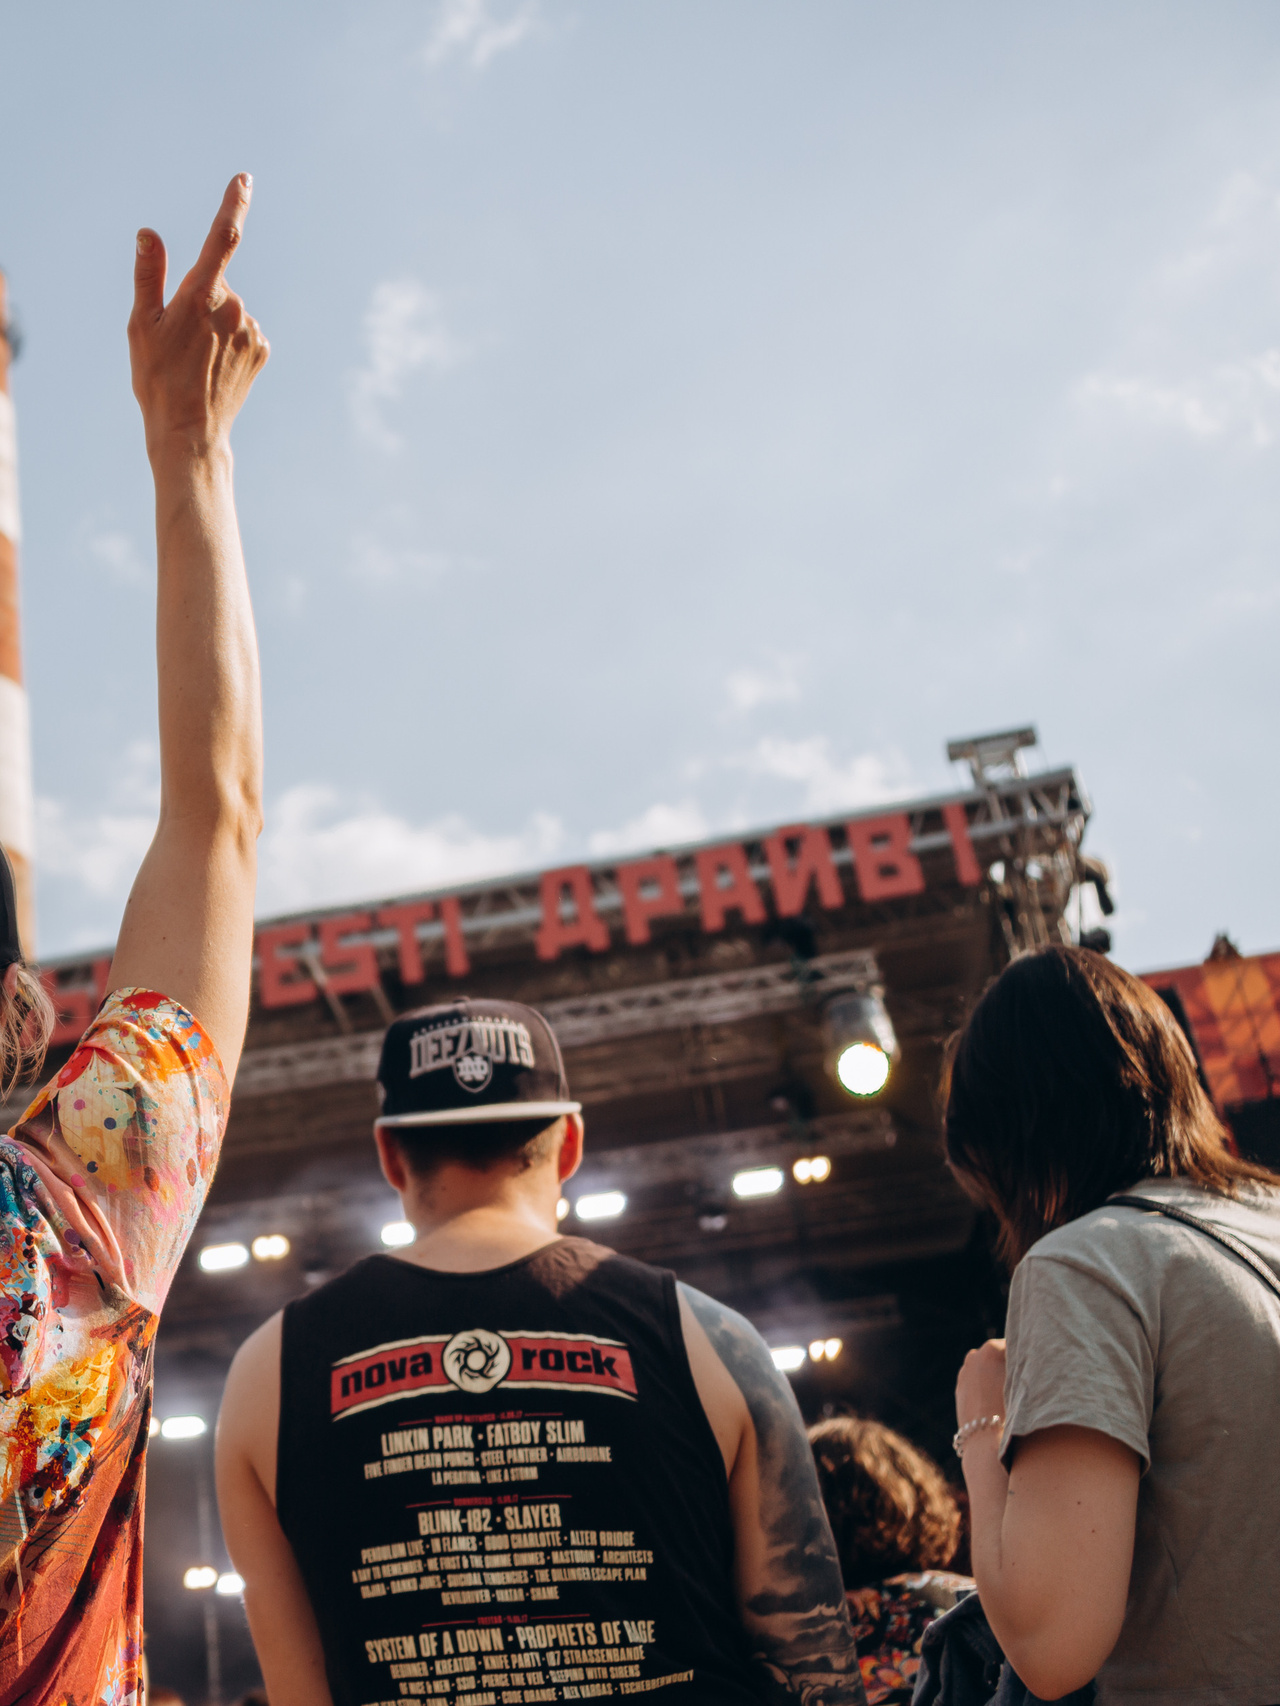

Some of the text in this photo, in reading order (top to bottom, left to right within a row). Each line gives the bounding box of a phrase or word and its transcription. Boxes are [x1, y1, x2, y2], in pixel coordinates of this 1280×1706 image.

[255, 896, 471, 1010] ESTI
[341, 1347, 620, 1398] nova rock
[381, 1420, 585, 1457] LINKIN PARK FATBOY SLIM
[363, 1460, 383, 1480] FIVE
[414, 1452, 442, 1470] DEATH
[443, 1451, 475, 1467] PUNCH
[481, 1450, 505, 1467] STEEL
[506, 1447, 548, 1465] PANTHER
[556, 1446, 612, 1462] AIRBOURNE
[432, 1471, 442, 1485] LA
[486, 1469, 503, 1484] LIKE
[503, 1468, 509, 1482] A
[510, 1466, 538, 1481] STORM
[418, 1504, 562, 1535] BLINK-182 SLAYER
[406, 1539, 425, 1557] LIVE
[430, 1537, 441, 1554] IN
[442, 1536, 477, 1552] FLAMES
[510, 1531, 562, 1549] CHARLOTTE
[570, 1530, 598, 1546] ALTER
[599, 1531, 635, 1546] BRIDGE
[469, 1555, 484, 1568] THE
[551, 1550, 595, 1564] MASTODON
[603, 1550, 653, 1564] ARCHITECTS
[534, 1569, 551, 1583] THE
[591, 1567, 623, 1581] ESCAPE
[624, 1567, 647, 1581] PLAN
[365, 1635, 417, 1663] SYSTEM
[419, 1632, 438, 1657] OF
[442, 1631, 454, 1655] A
[456, 1627, 504, 1653] DOWN
[516, 1622, 597, 1649] PROPHETS
[601, 1621, 621, 1645] OF
[434, 1656, 477, 1675] KREATOR
[482, 1654, 510, 1670] KNIFE
[510, 1651, 541, 1669] PARTY
[563, 1645, 646, 1665] STRASSENBANDE
[481, 1673, 510, 1688] PIERCE
[510, 1672, 526, 1686] THE
[526, 1671, 545, 1685] VEIL
[585, 1666, 608, 1679] WITH
[609, 1664, 641, 1679] SIRENS
[580, 1683, 613, 1698] VARGAS
